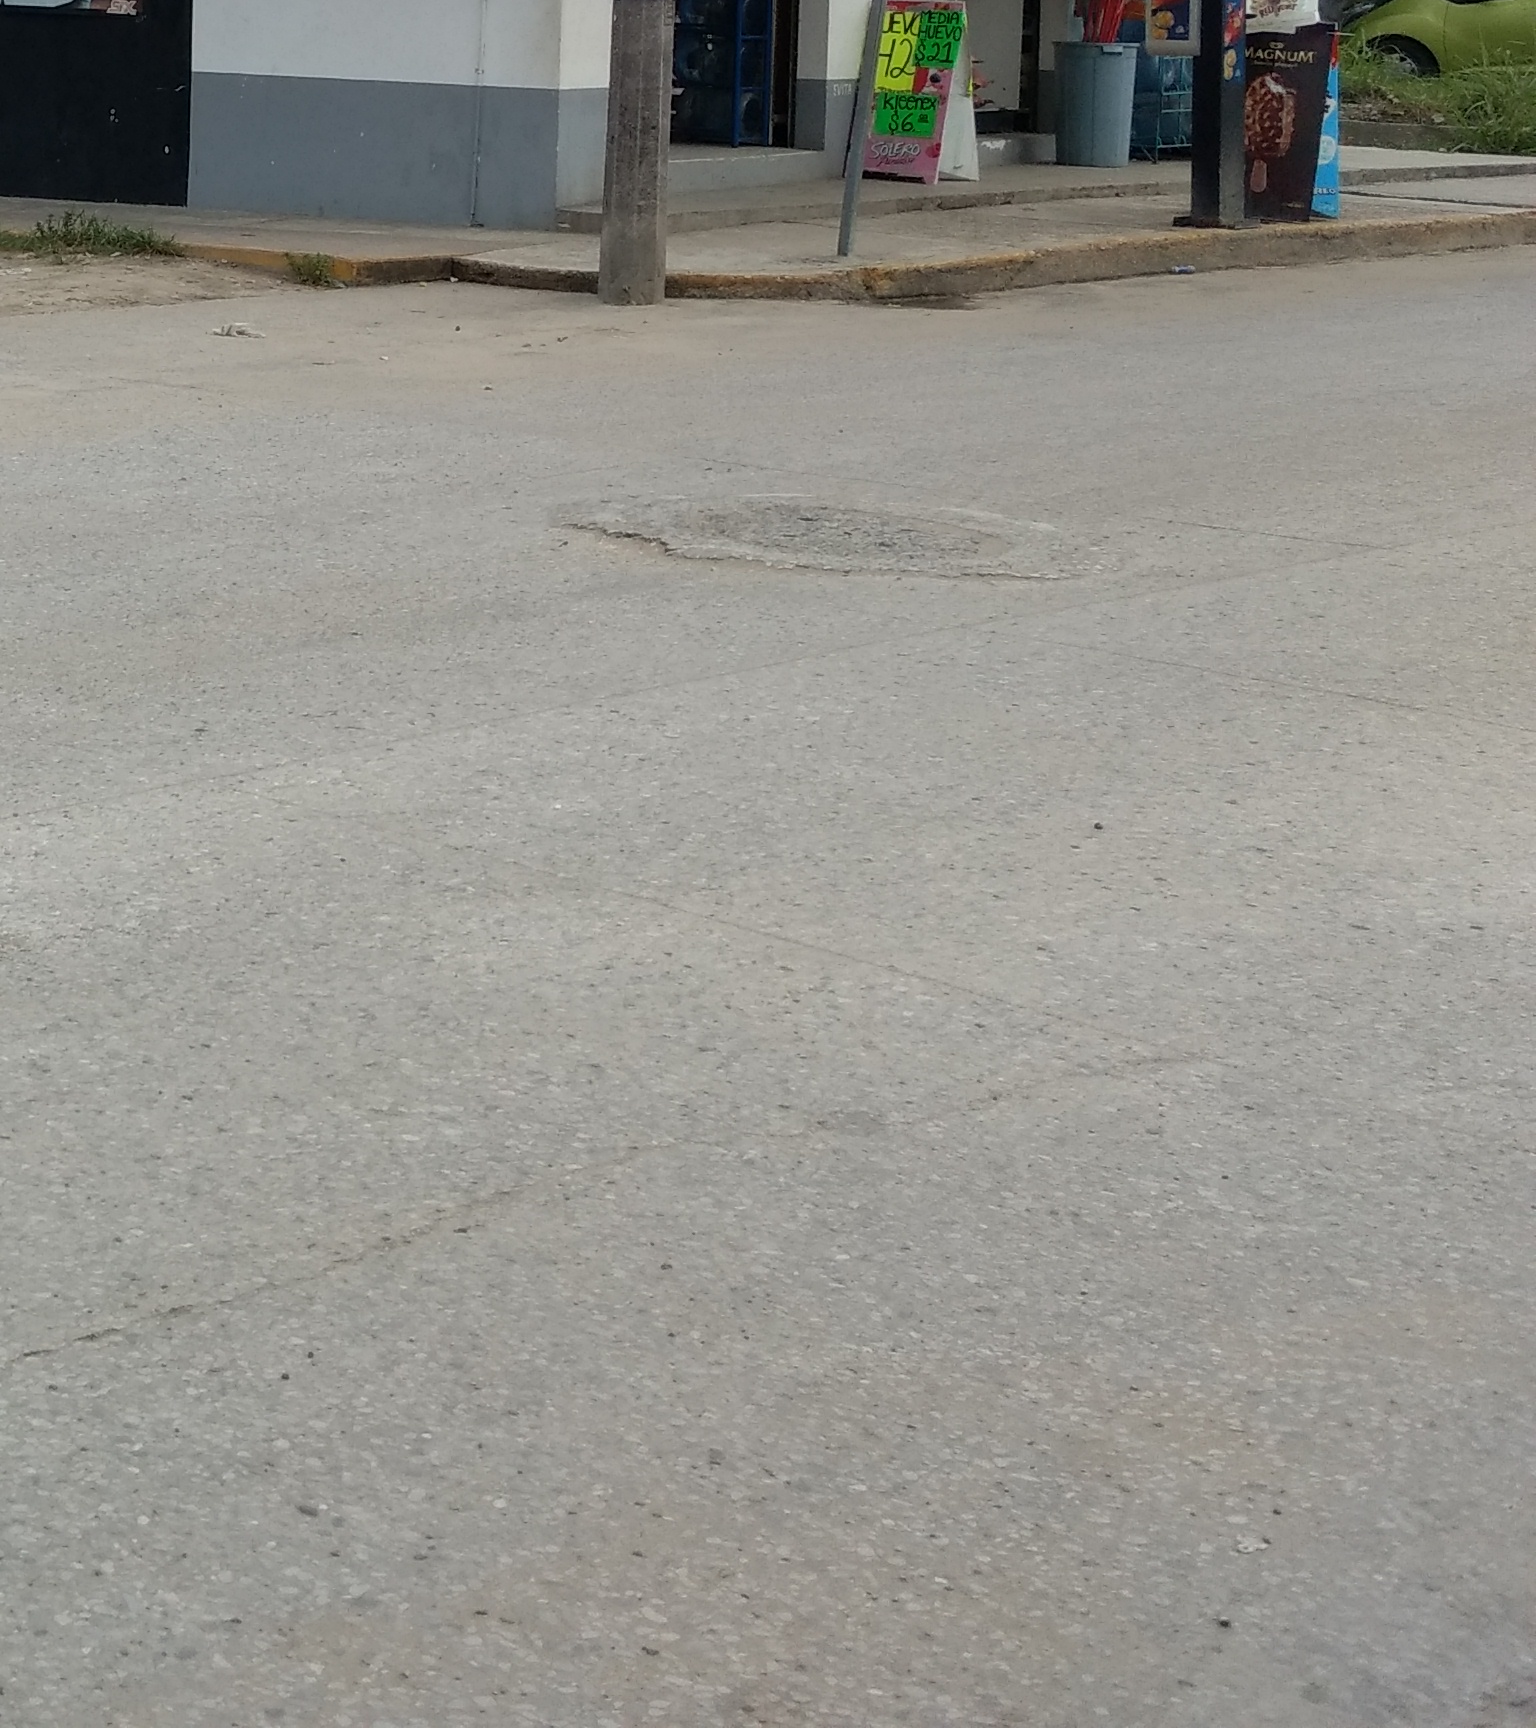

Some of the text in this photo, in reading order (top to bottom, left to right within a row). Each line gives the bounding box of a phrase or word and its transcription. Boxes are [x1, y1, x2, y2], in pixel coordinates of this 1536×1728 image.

[920, 10, 960, 25] MEDIA
[917, 24, 962, 41] HUEVO
[1245, 48, 1316, 64] MAGNUM
[870, 140, 921, 159] SOLERO
